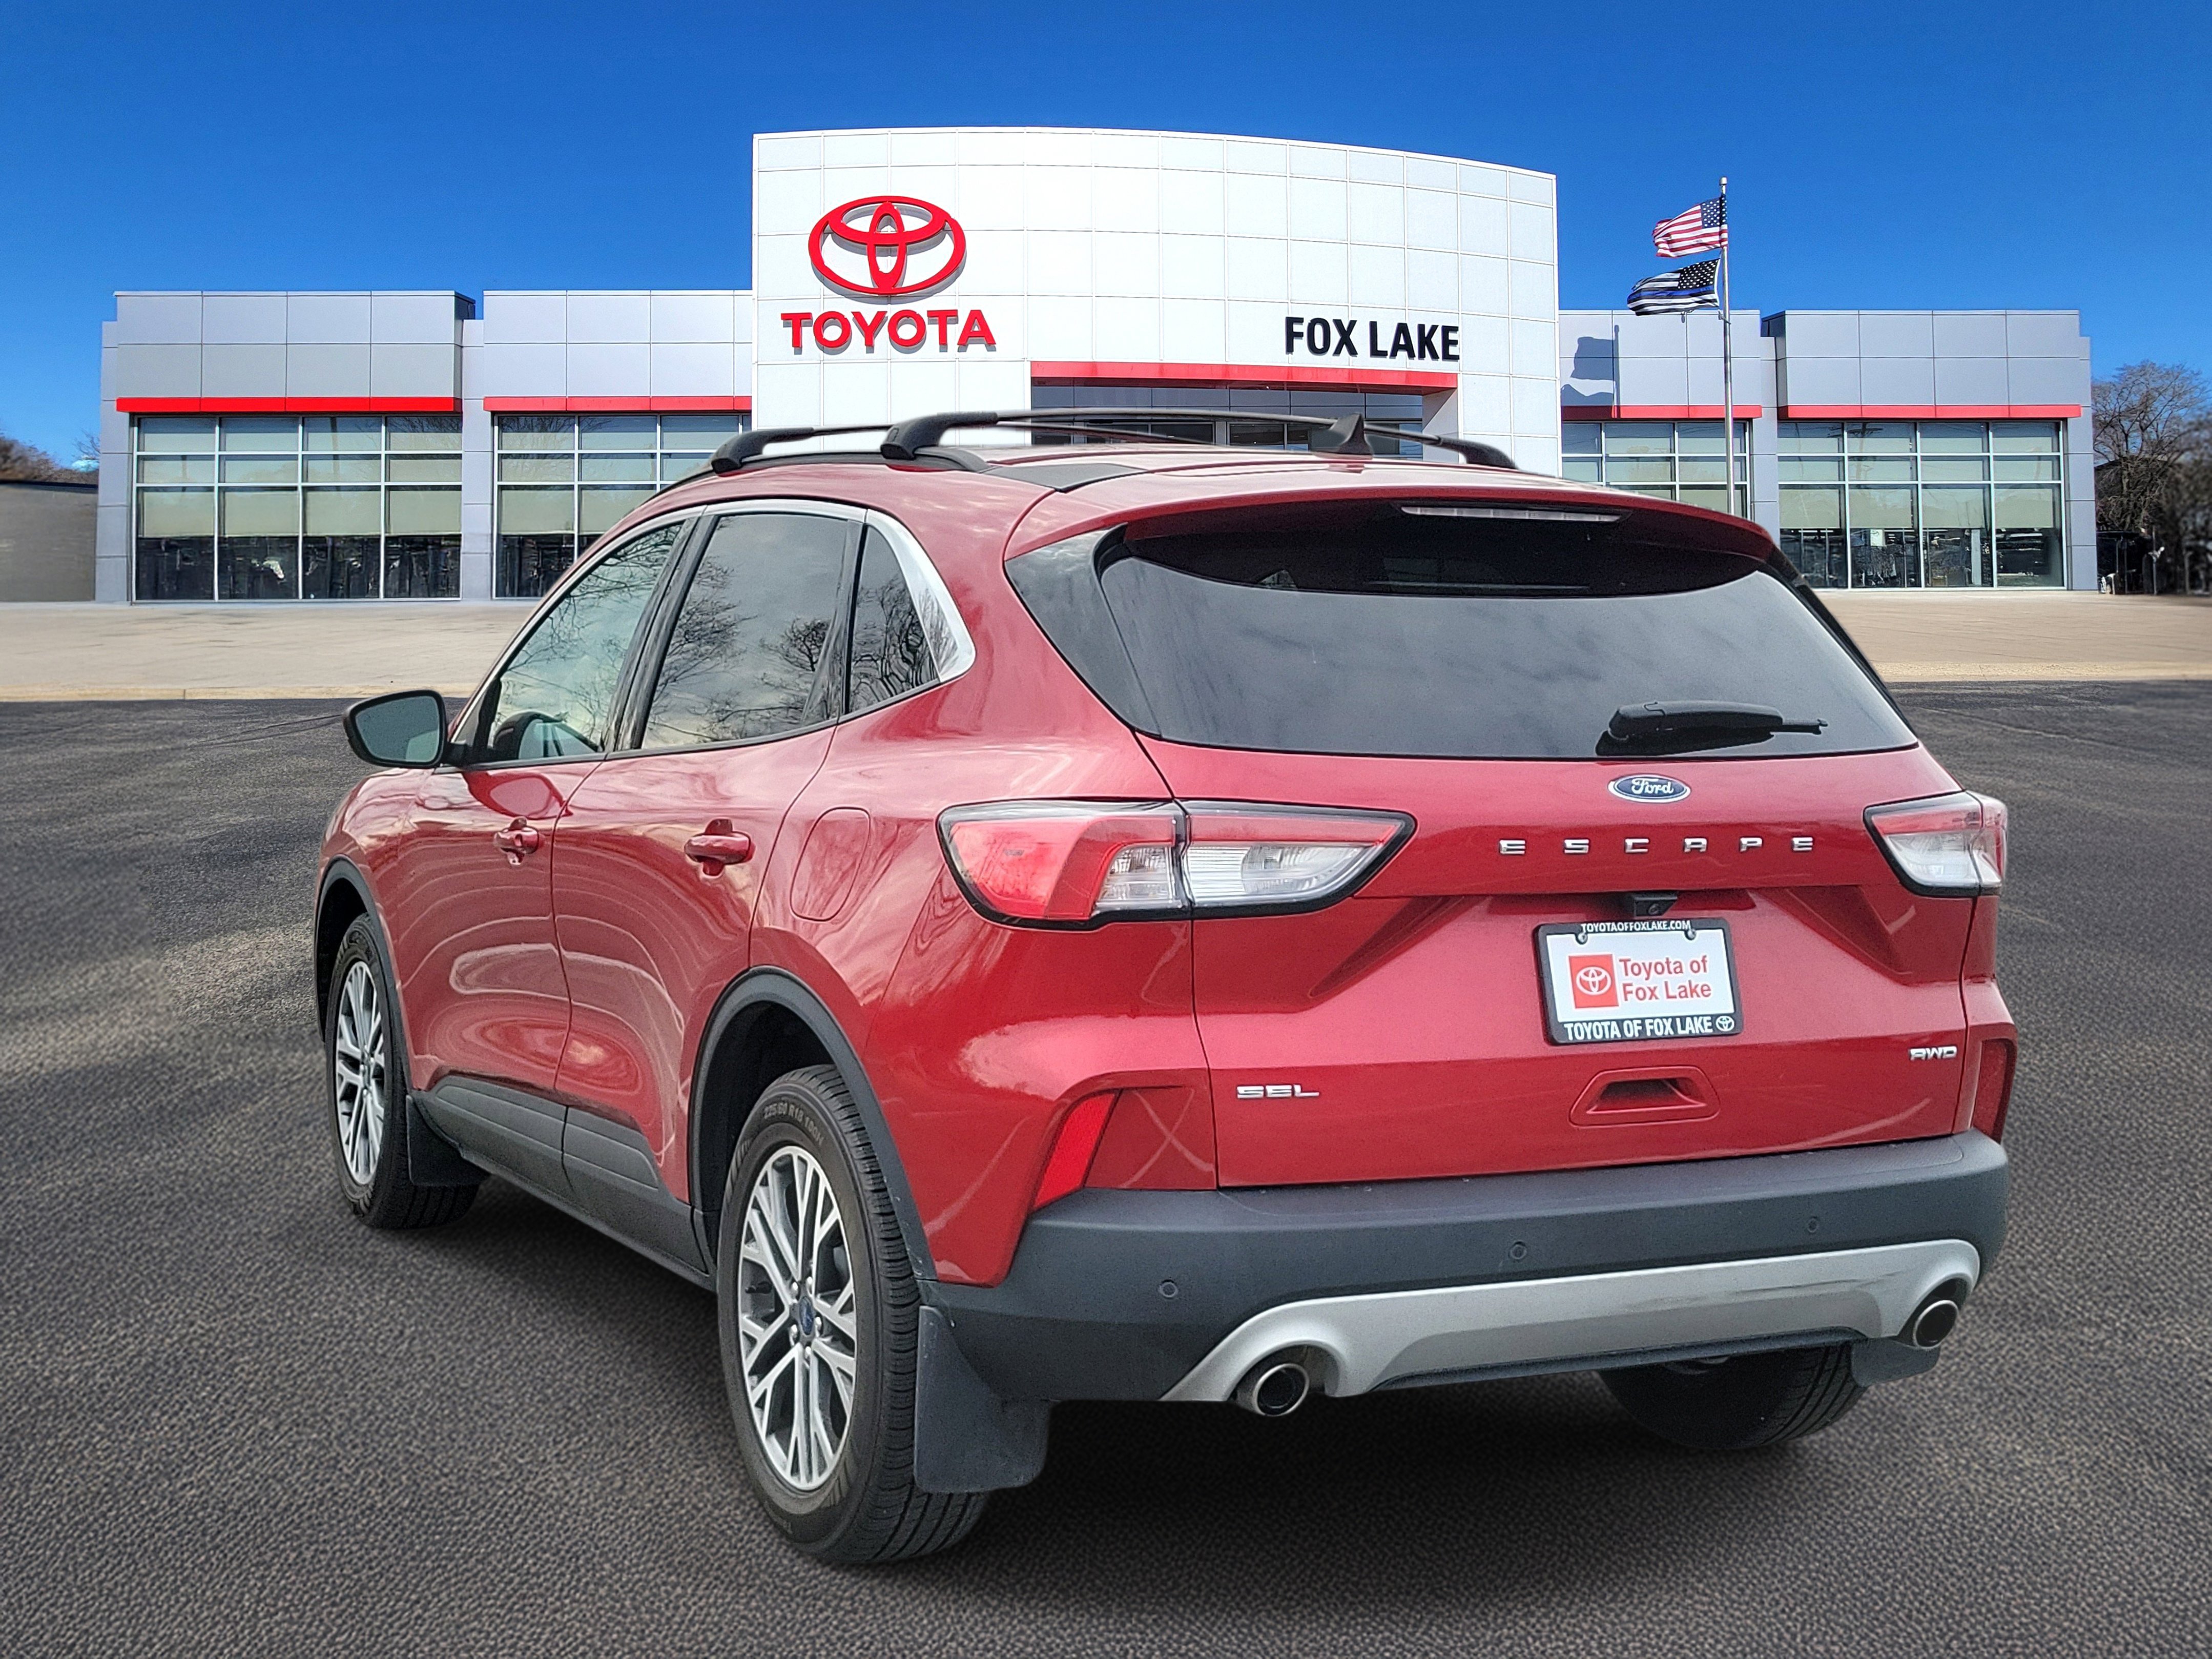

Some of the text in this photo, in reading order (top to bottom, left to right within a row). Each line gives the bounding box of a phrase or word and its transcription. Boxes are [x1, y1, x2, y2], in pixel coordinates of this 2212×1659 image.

[780, 309, 997, 350] TOYOTA
[1285, 316, 1460, 360] FOX LAKE
[1631, 777, 1674, 795] Ford
[1498, 837, 1814, 855] ESCAPE
[1581, 920, 1691, 933] TOYOTAOFFOXLAKE.COM
[1619, 955, 1708, 980] Toyota of
[1622, 979, 1712, 1001] Fox Lake
[1564, 1016, 1713, 1041] TOYOTA OF FOX LAKE
[1910, 1046, 1957, 1061] AWD
[1236, 1084, 1320, 1099] SEL
